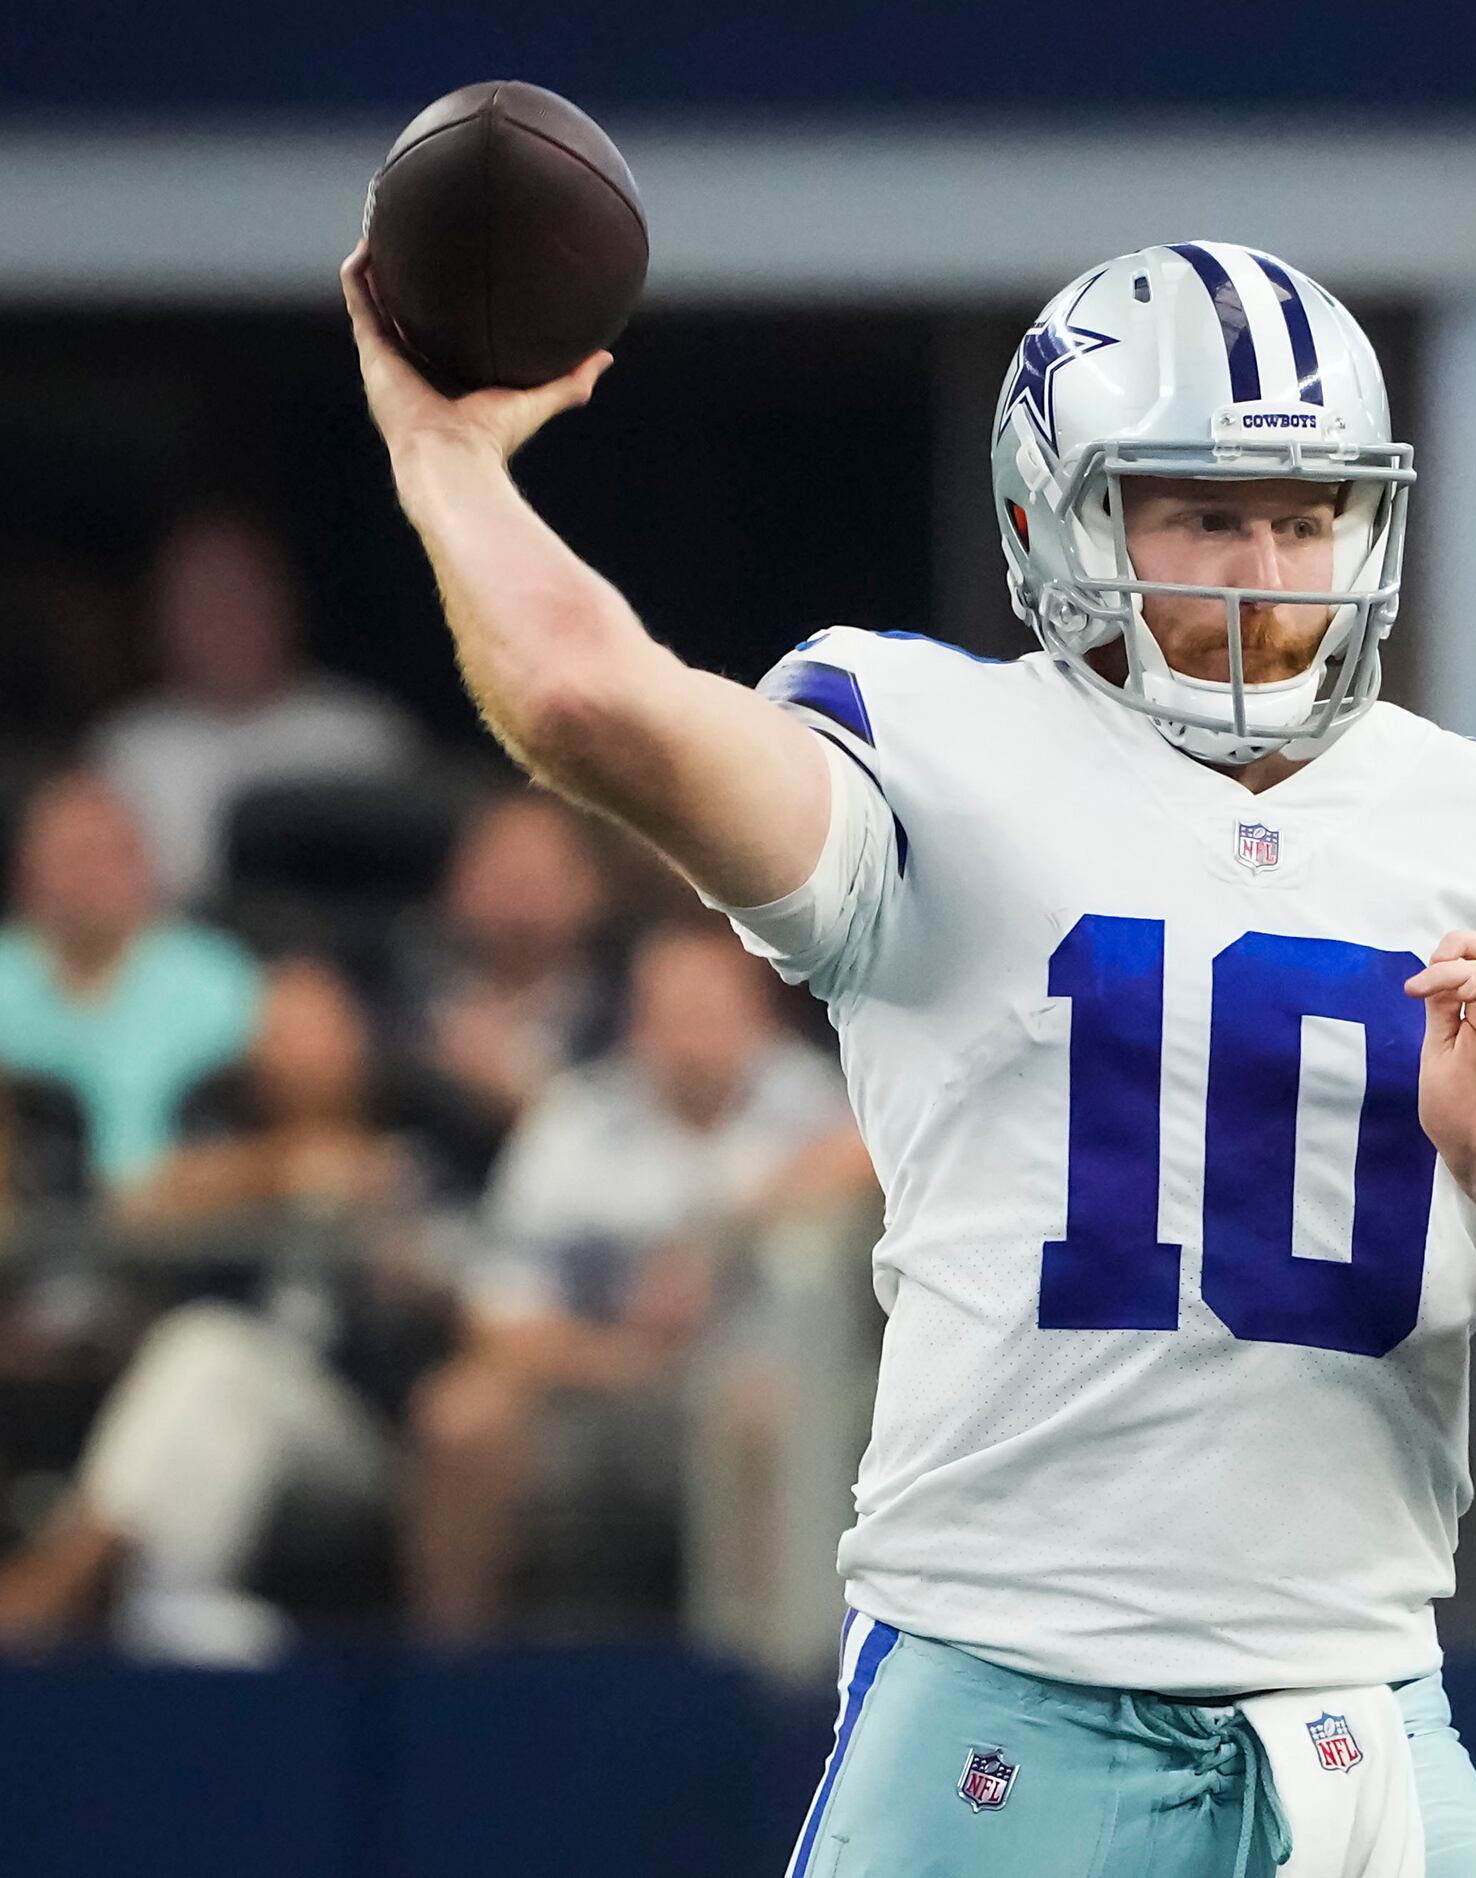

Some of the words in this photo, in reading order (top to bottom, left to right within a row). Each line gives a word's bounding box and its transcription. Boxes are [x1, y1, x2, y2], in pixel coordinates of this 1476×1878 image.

[1242, 413, 1317, 428] COWBOYS
[1242, 838, 1277, 864] NFL
[1038, 912, 1439, 1359] 10
[1318, 1737, 1359, 1767] NFL
[966, 1772, 1001, 1802] NFL
